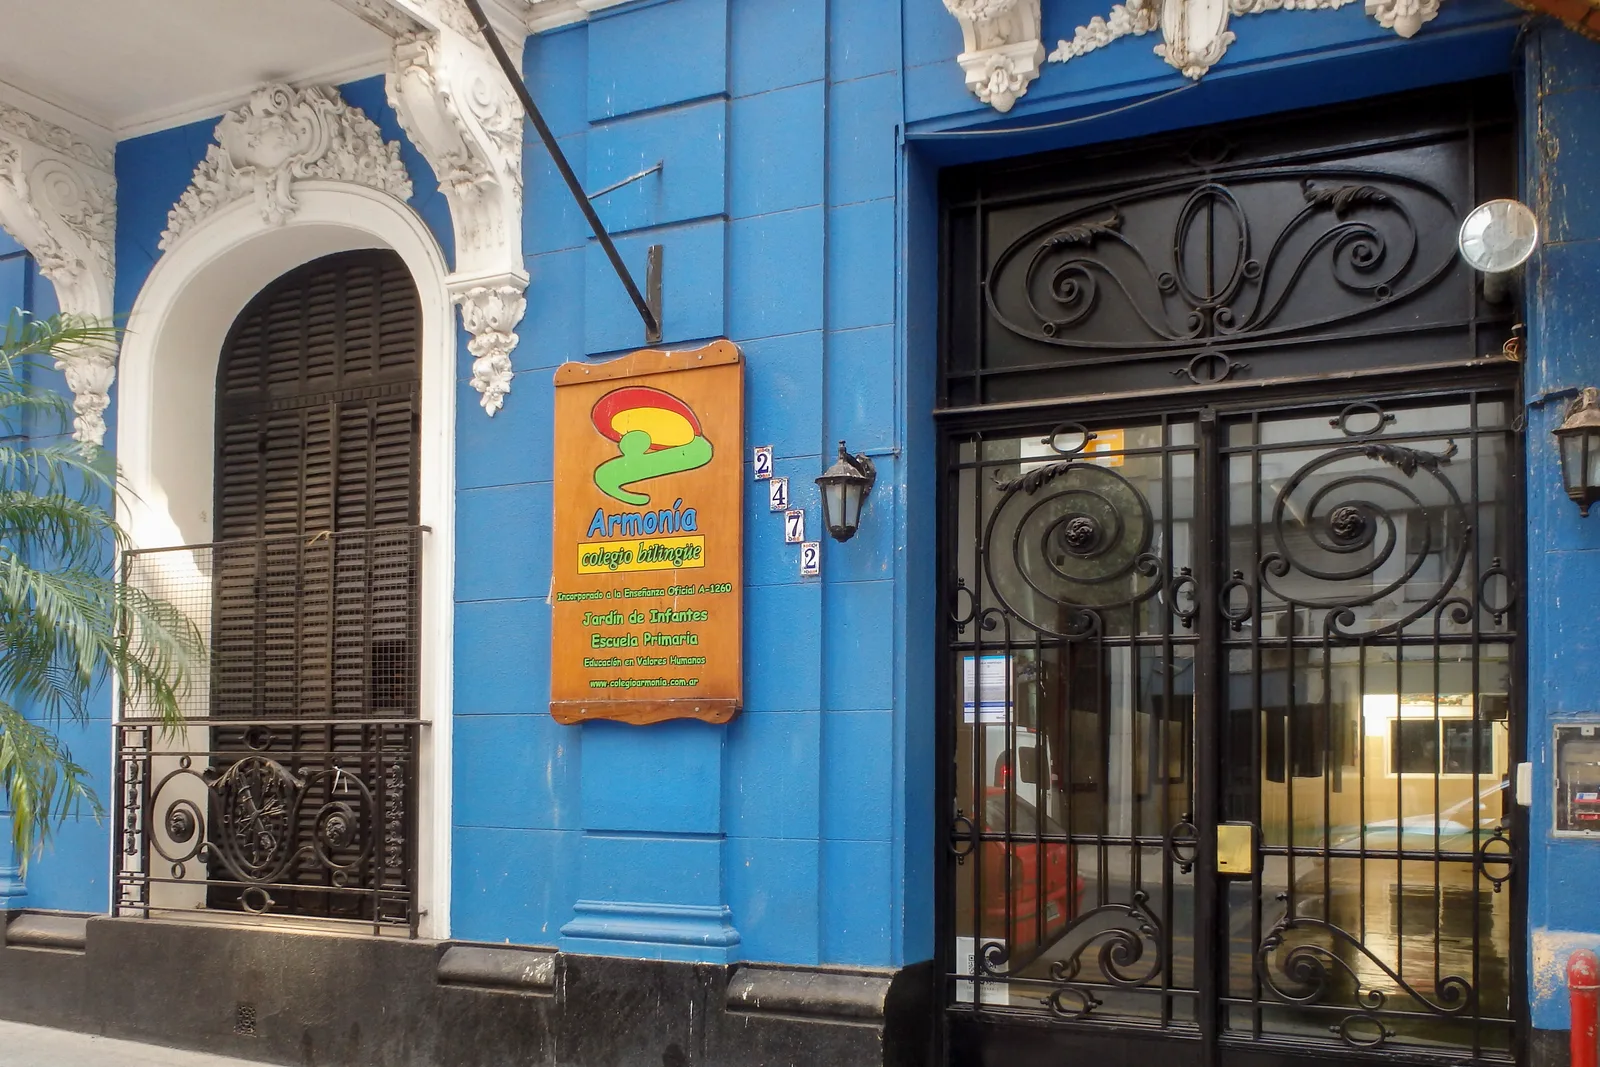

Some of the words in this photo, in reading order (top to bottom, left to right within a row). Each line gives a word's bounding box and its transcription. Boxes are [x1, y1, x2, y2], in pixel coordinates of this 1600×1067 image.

[587, 498, 697, 538] Armonía
[582, 547, 633, 571] colegio
[637, 542, 702, 567] bilingüe
[557, 590, 603, 602] Incorporado
[606, 591, 612, 599] a
[613, 589, 621, 598] la
[624, 587, 665, 598] Enseñanza
[667, 585, 695, 596] Oficial
[698, 583, 732, 594] A-1260
[582, 610, 624, 627] Jardín
[628, 609, 645, 624] de
[649, 608, 708, 624] Infantes
[591, 633, 638, 649] Escuela
[643, 631, 699, 647] Primaria
[583, 657, 622, 668] Educación
[624, 658, 634, 667] en
[636, 656, 667, 666] Valores
[669, 655, 706, 665] Humanos
